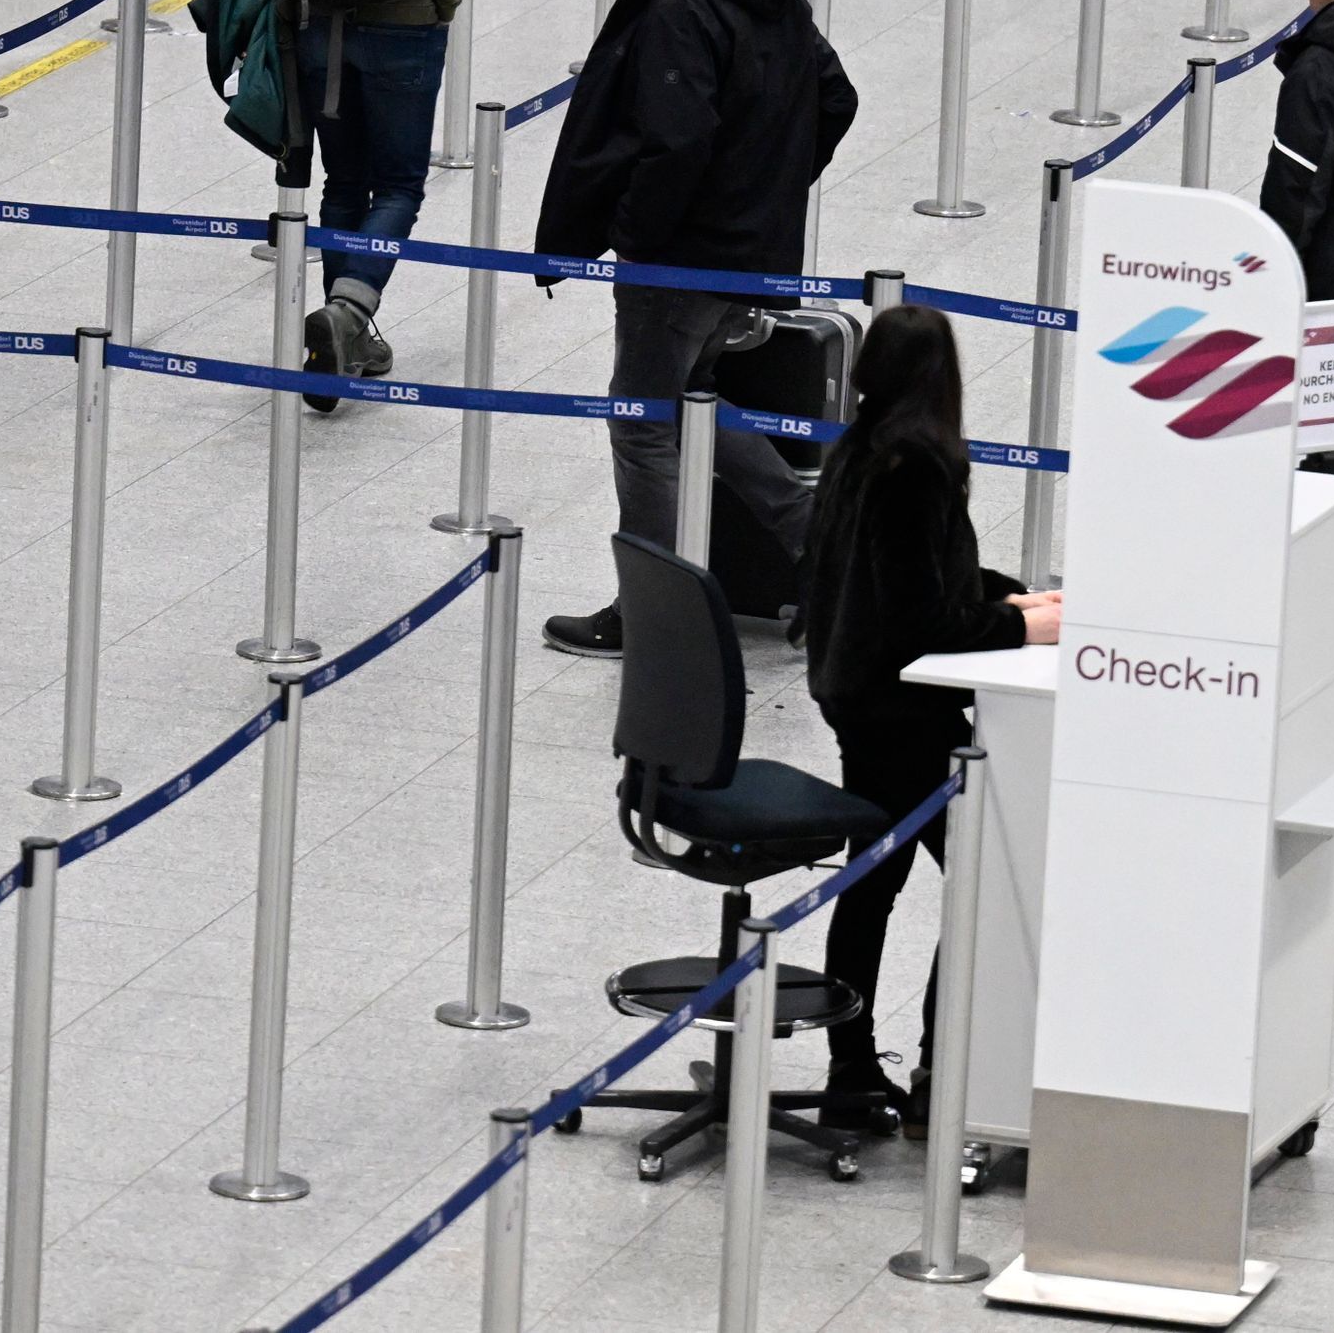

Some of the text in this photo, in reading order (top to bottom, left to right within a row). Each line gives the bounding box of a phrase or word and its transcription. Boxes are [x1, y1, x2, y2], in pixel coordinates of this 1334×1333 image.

[2, 206, 29, 220] DUS
[210, 221, 237, 235] DUS
[372, 238, 400, 254] DUS
[587, 263, 615, 277] DUS
[1102, 253, 1231, 291] Eurowings
[803, 280, 831, 294] DUS
[1038, 309, 1066, 326] DUS
[15, 337, 44, 351] DUS
[167, 357, 197, 374] DUS
[390, 386, 419, 402] DUS
[1303, 394, 1319, 405] NO
[614, 401, 644, 417] DUS
[782, 420, 811, 436] DUS
[1008, 448, 1038, 465] DUS
[1075, 645, 1260, 698] Check-in
